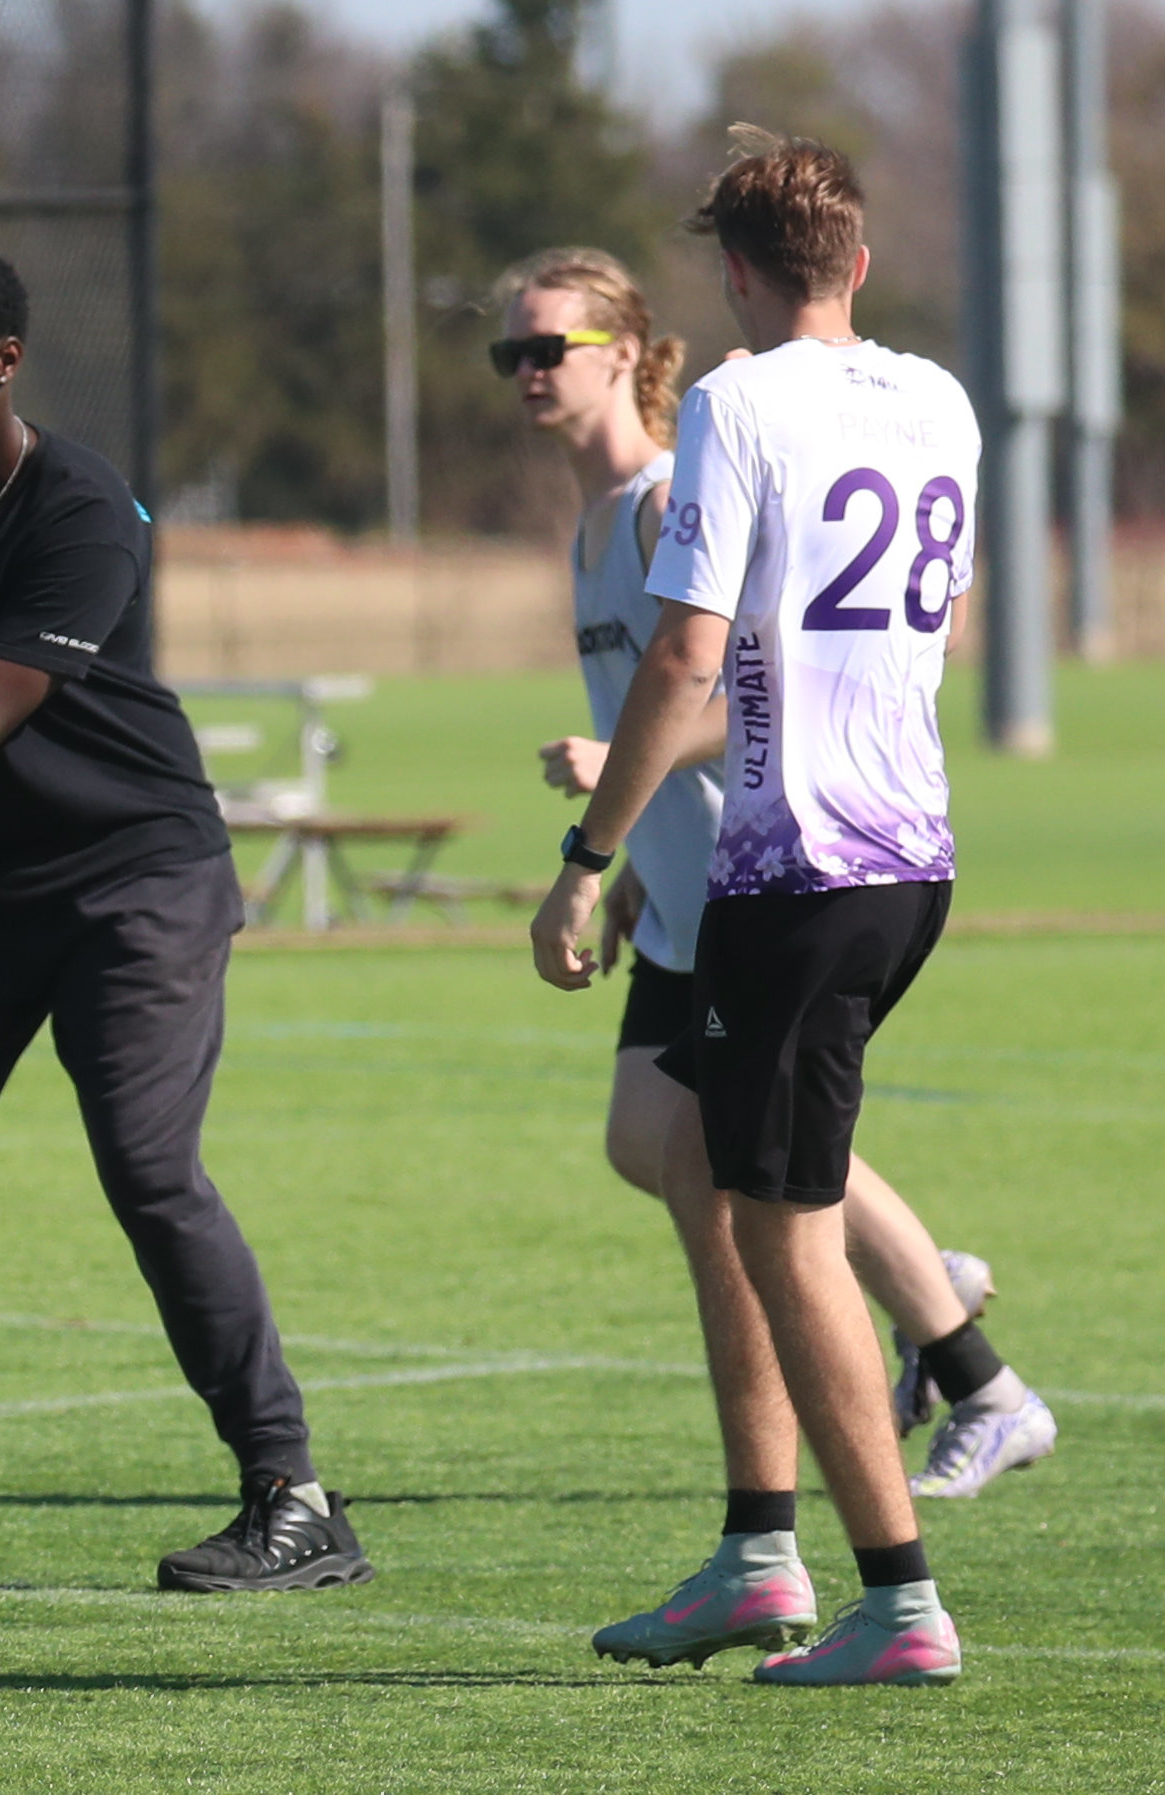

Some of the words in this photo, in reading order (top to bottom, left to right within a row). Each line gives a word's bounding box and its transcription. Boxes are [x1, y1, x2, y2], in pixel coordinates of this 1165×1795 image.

[838, 411, 938, 448] PAYNE
[801, 466, 965, 634] 28
[736, 631, 771, 790] ULTIMATE
